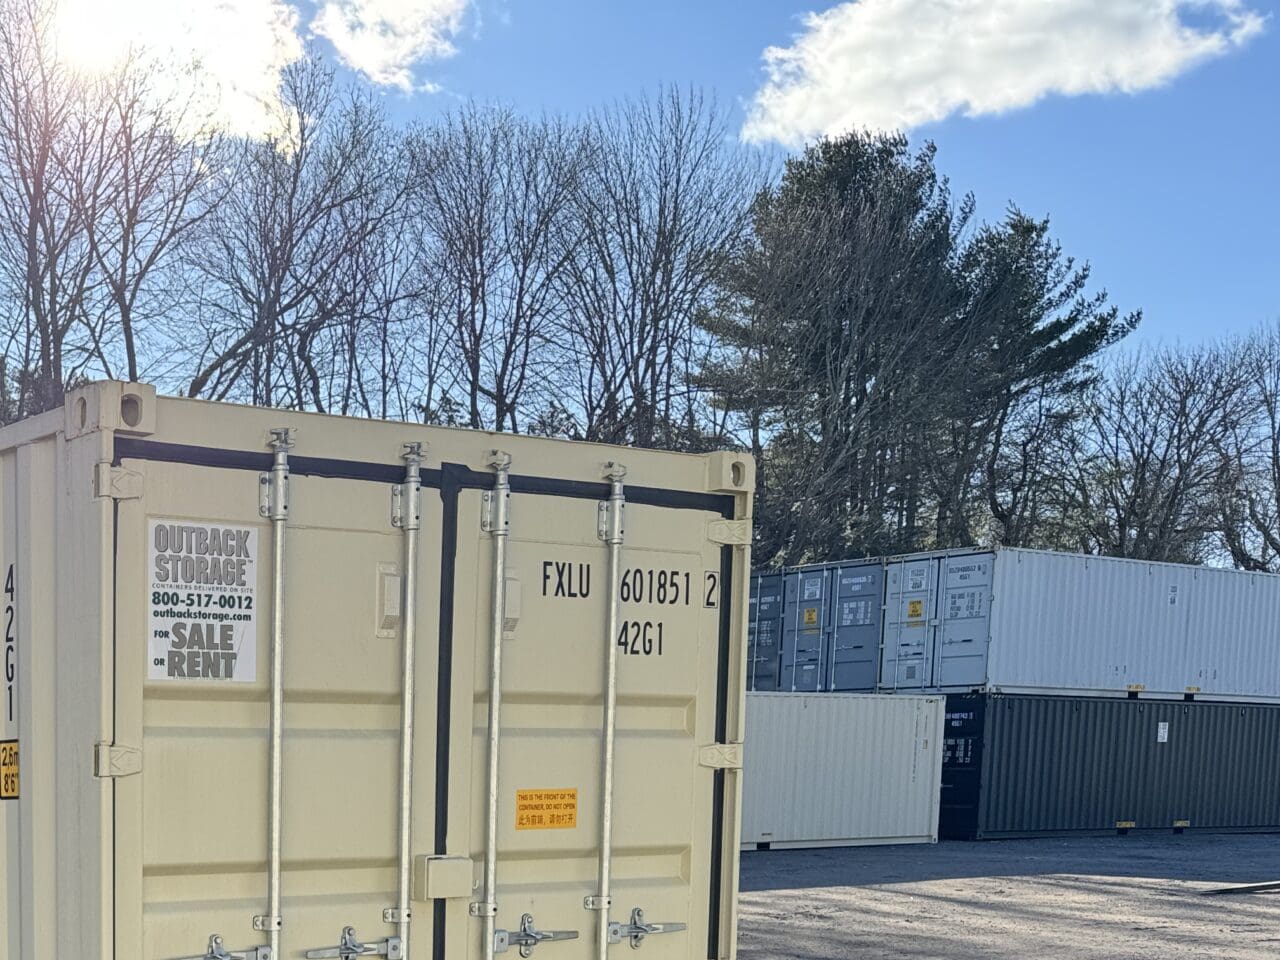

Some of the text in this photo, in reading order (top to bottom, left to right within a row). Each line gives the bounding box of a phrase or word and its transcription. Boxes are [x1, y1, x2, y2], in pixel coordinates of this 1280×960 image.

[154, 524, 250, 558] OUTBACK
[152, 583, 192, 591] CONTAINERS
[542, 561, 717, 607] FXLU 601851 2
[152, 592, 253, 609] 800-517-0012
[153, 608, 252, 622] outbackstorage.com
[4, 564, 15, 721] 42G1
[154, 622, 234, 651] FOR SALE
[618, 621, 663, 655] 42G1
[153, 650, 237, 678] OR RENT
